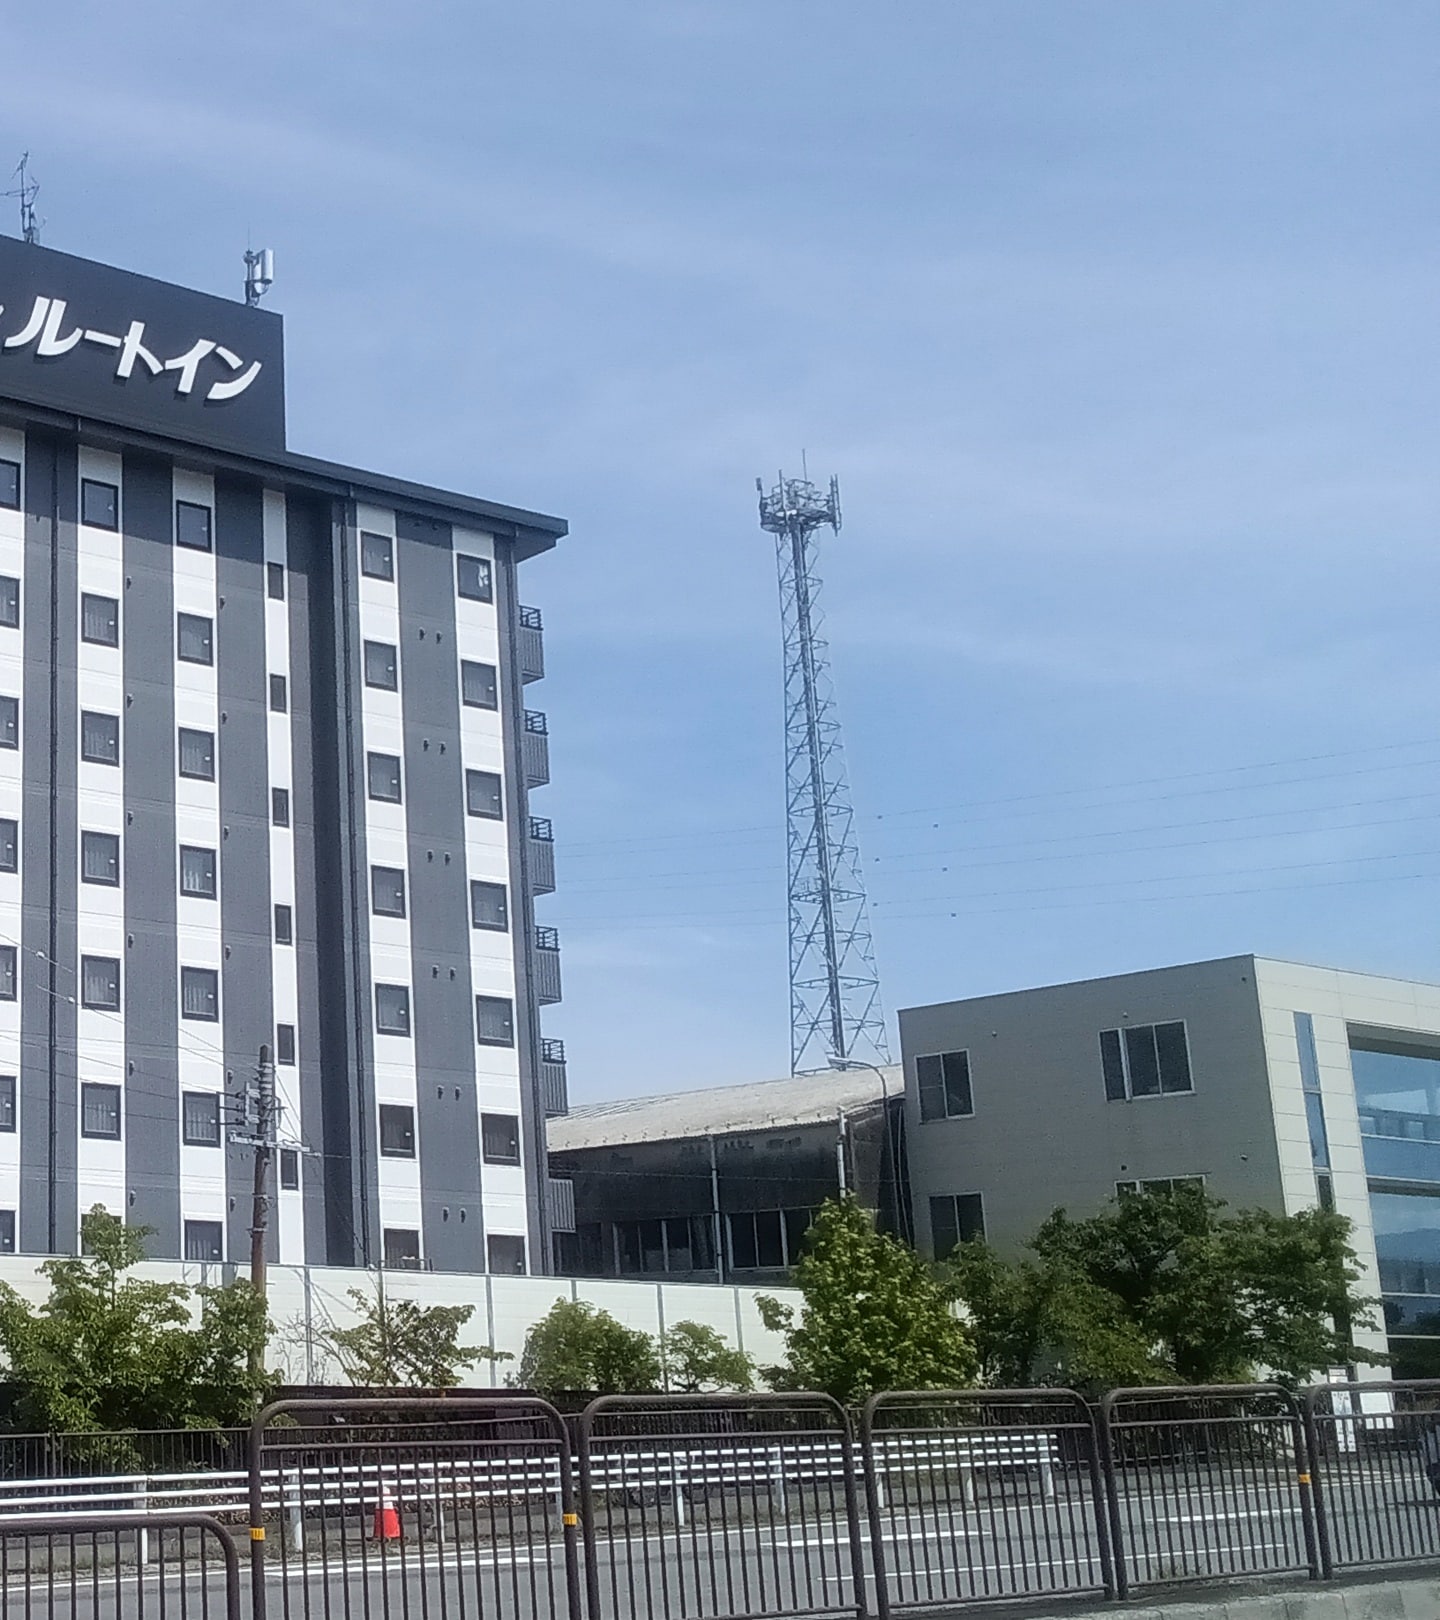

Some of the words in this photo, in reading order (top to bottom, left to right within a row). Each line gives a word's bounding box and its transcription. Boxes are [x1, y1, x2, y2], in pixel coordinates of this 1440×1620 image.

[4, 296, 262, 400] ルートイン
